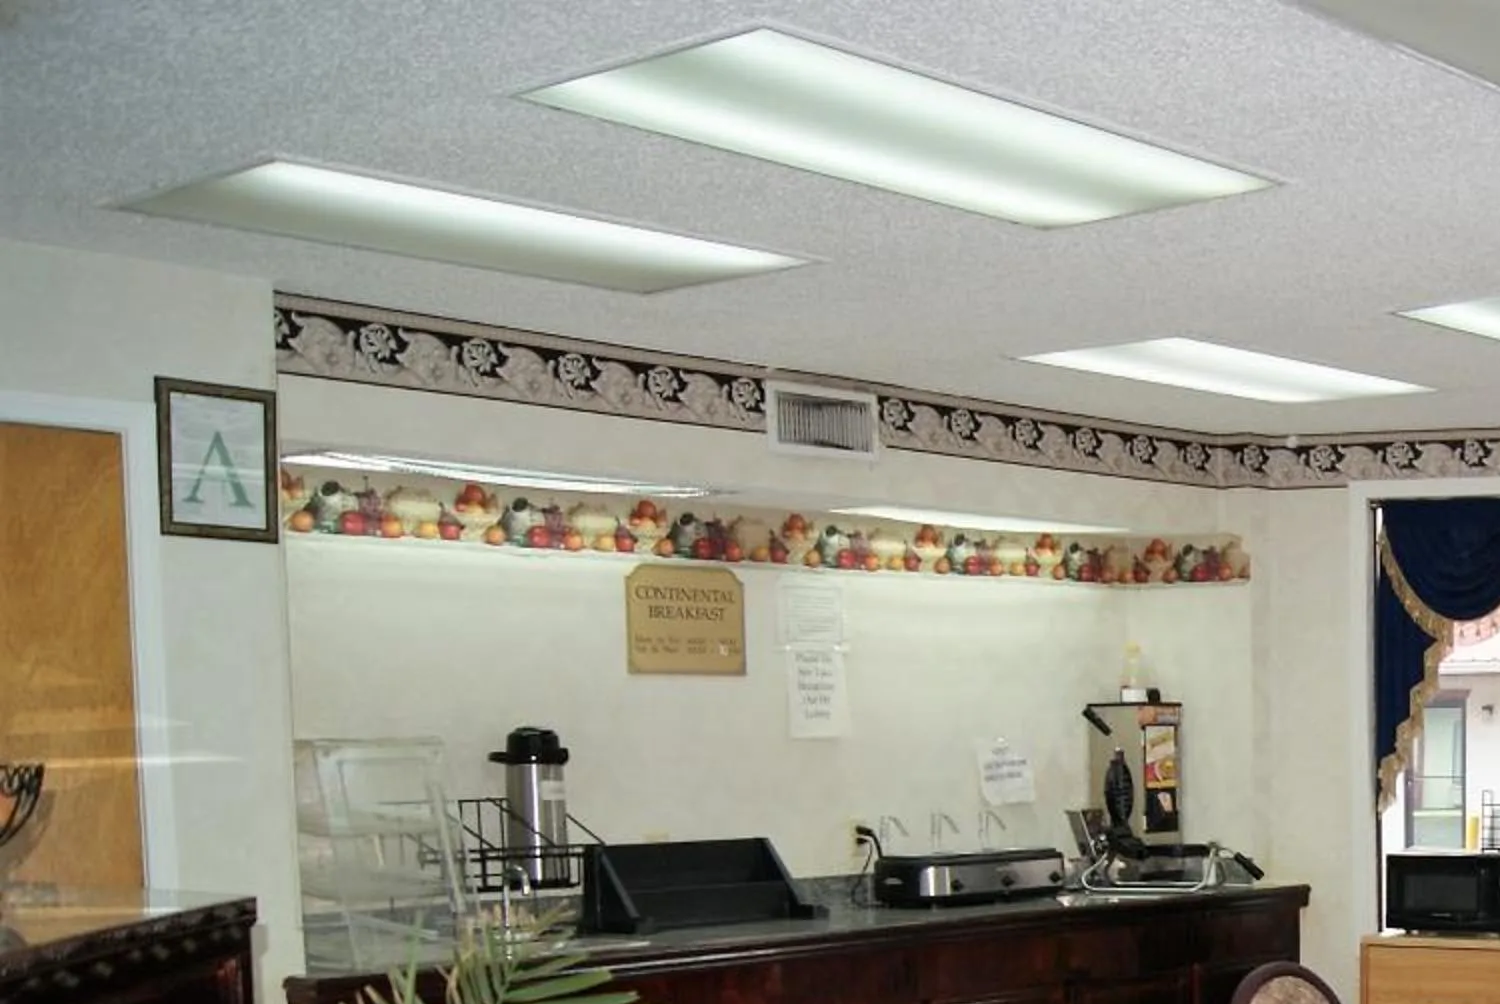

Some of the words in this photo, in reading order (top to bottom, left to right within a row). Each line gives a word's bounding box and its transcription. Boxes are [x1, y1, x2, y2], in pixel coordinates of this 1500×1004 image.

[182, 431, 255, 508] A
[634, 584, 736, 604] CONTINENTAL
[648, 605, 726, 621] BREAKFAST
